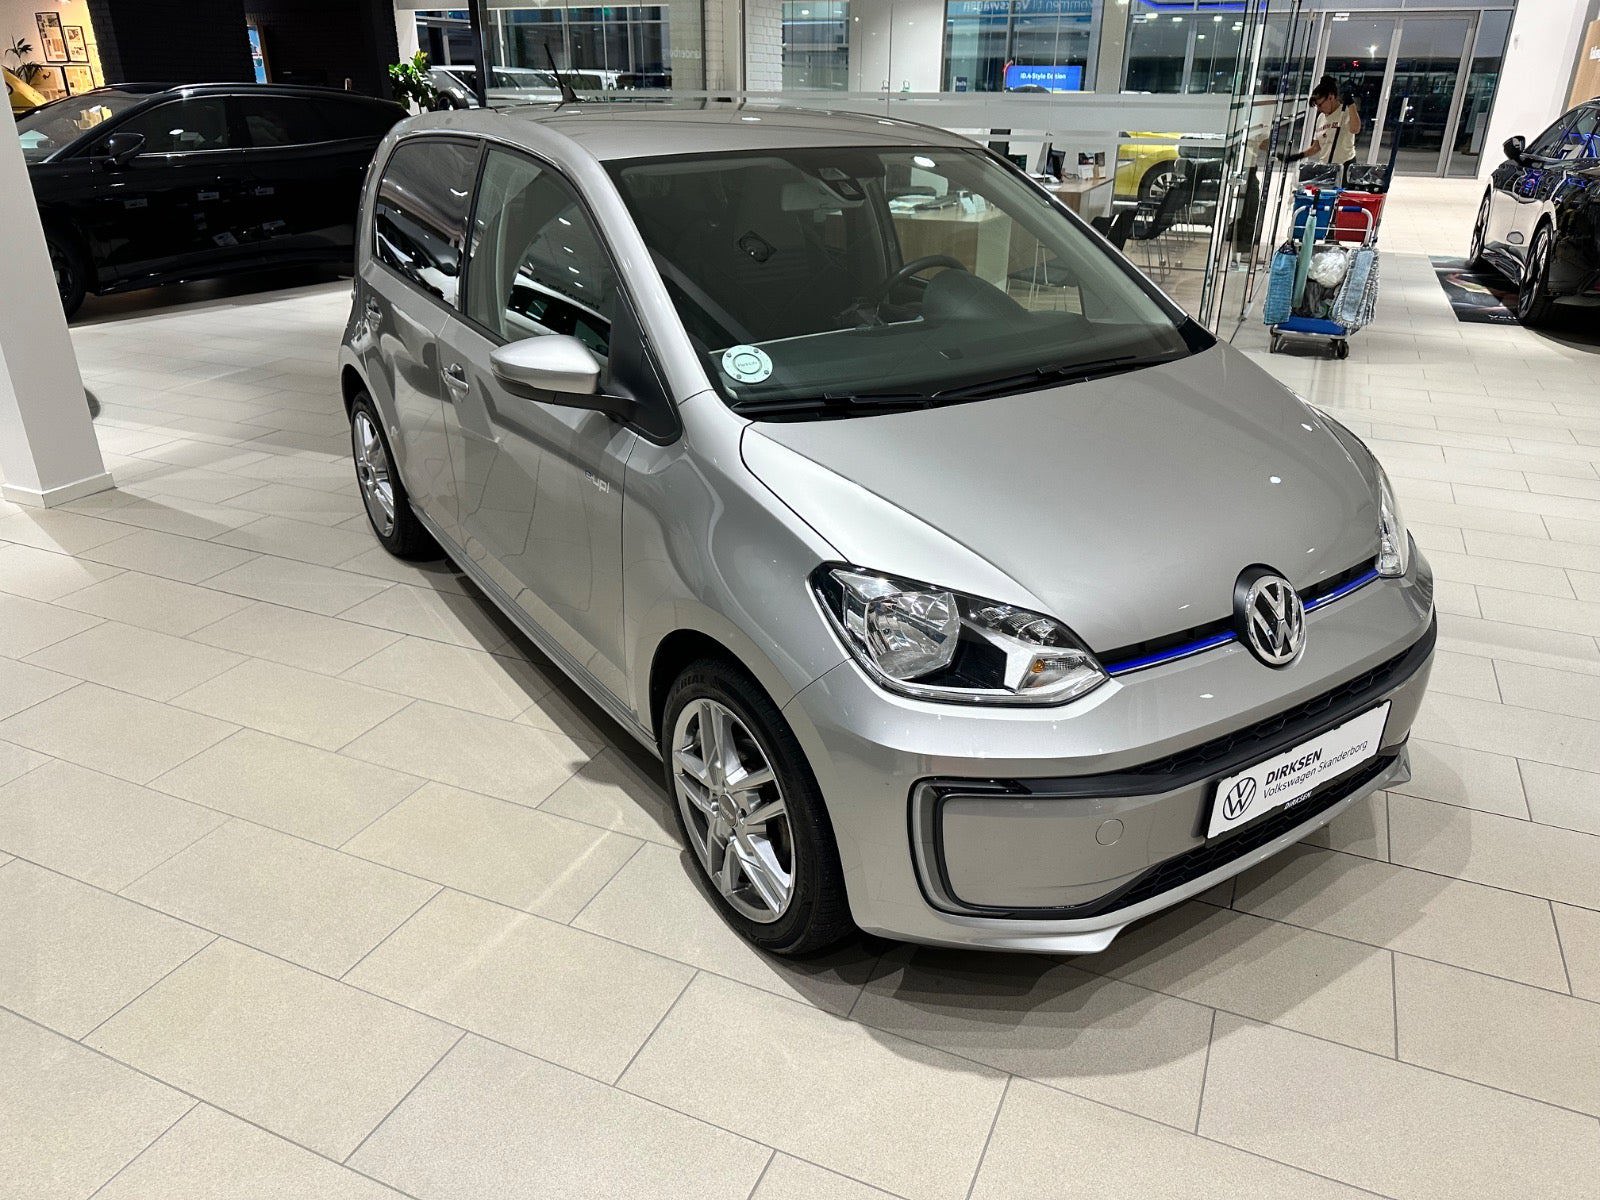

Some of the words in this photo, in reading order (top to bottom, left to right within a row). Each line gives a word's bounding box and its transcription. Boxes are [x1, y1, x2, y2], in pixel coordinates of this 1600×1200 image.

[1046, 72, 1067, 80] Edtion
[1263, 768, 1317, 799] Volkswagen
[1317, 740, 1369, 773] Skanderborg
[1265, 748, 1323, 786] DIRKSEN
[1283, 791, 1313, 810] DIRKSEN
